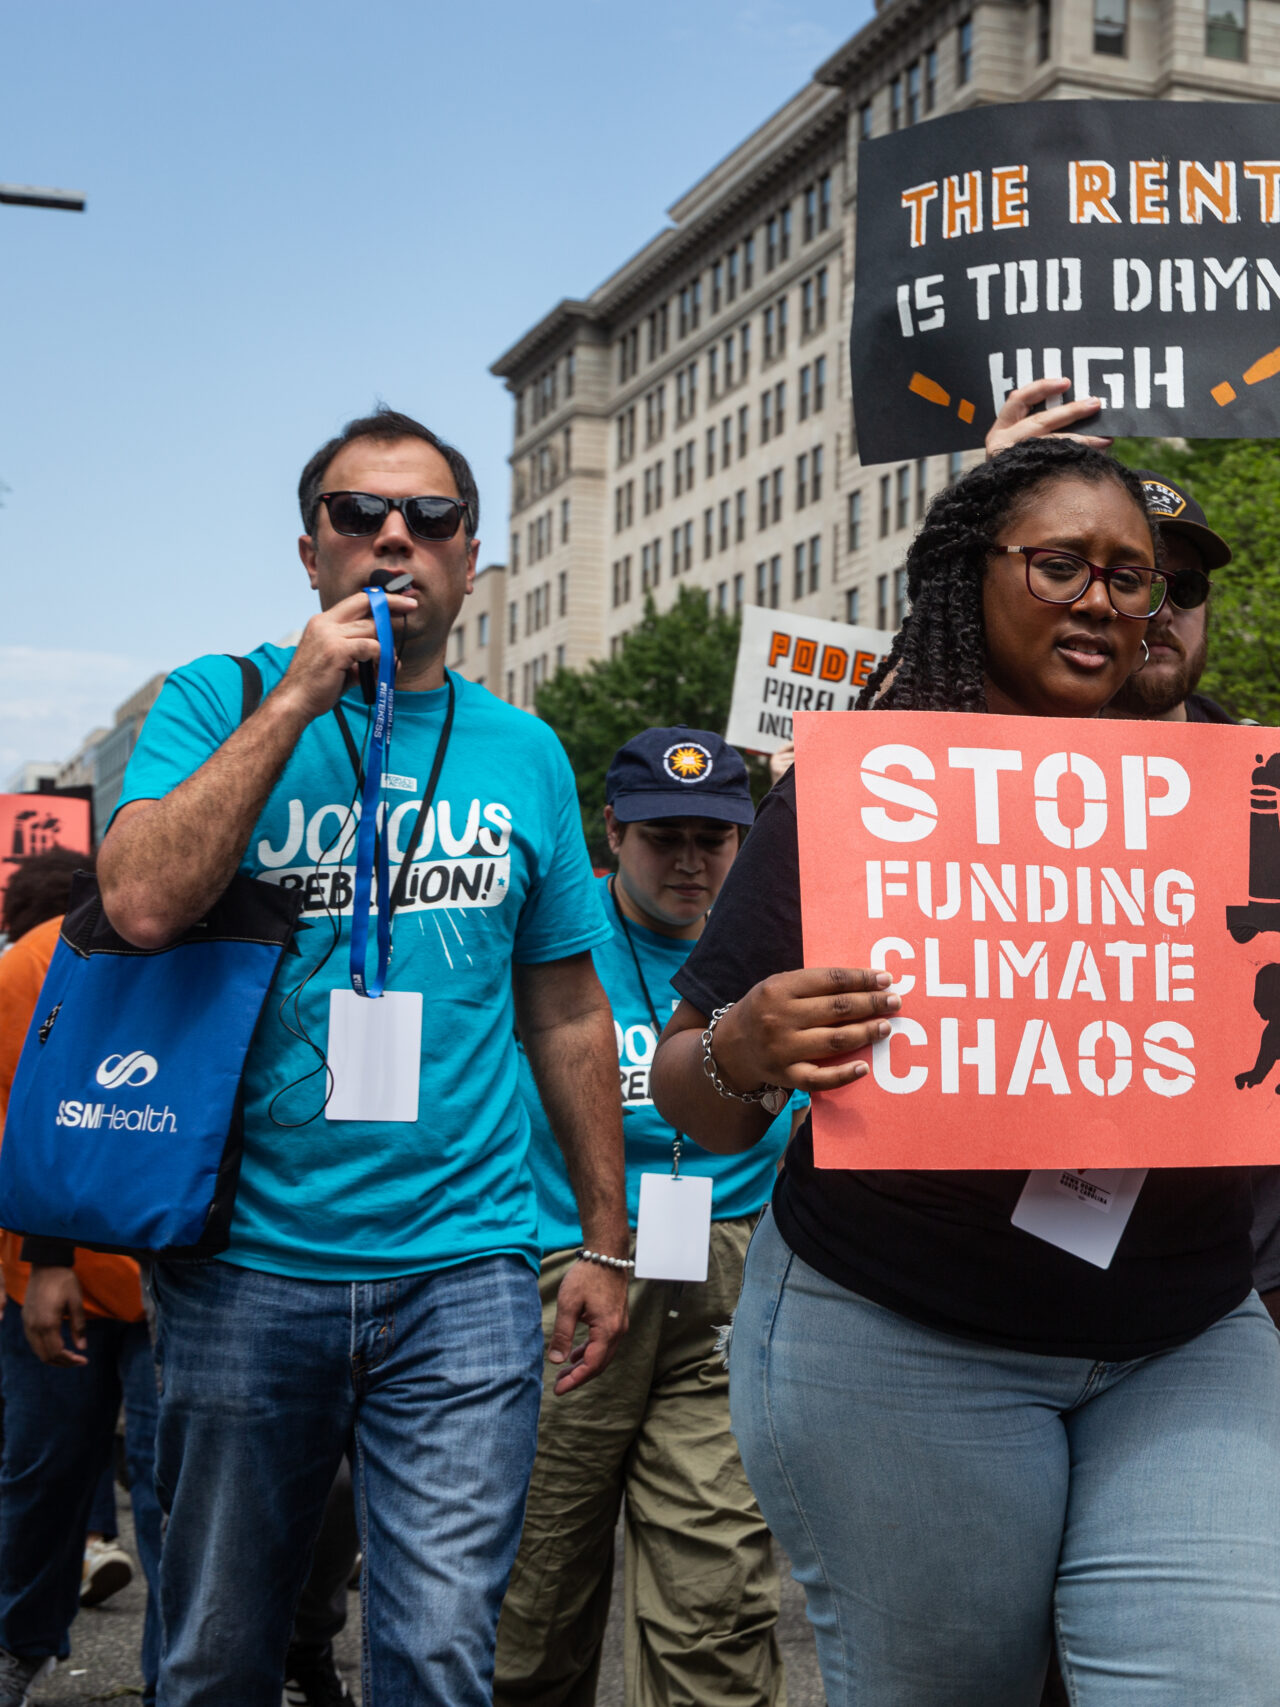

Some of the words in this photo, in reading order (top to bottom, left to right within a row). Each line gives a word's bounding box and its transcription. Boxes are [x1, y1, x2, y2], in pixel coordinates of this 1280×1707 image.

[901, 164, 1029, 248] THE
[897, 273, 945, 338] IS
[966, 257, 1082, 321] TOO
[988, 346, 1186, 418] HIGH
[1156, 485, 1181, 504] SEAS
[768, 630, 888, 688] PODE
[374, 682, 387, 738] RETEKESS
[860, 744, 1191, 849] STOP
[258, 798, 512, 868] JOOUS
[866, 859, 1196, 927] FUNDING
[870, 936, 1195, 1002] CLIMATE
[871, 1016, 1196, 1097] CHAOS
[1079, 1189, 1107, 1205] CAROLINA
